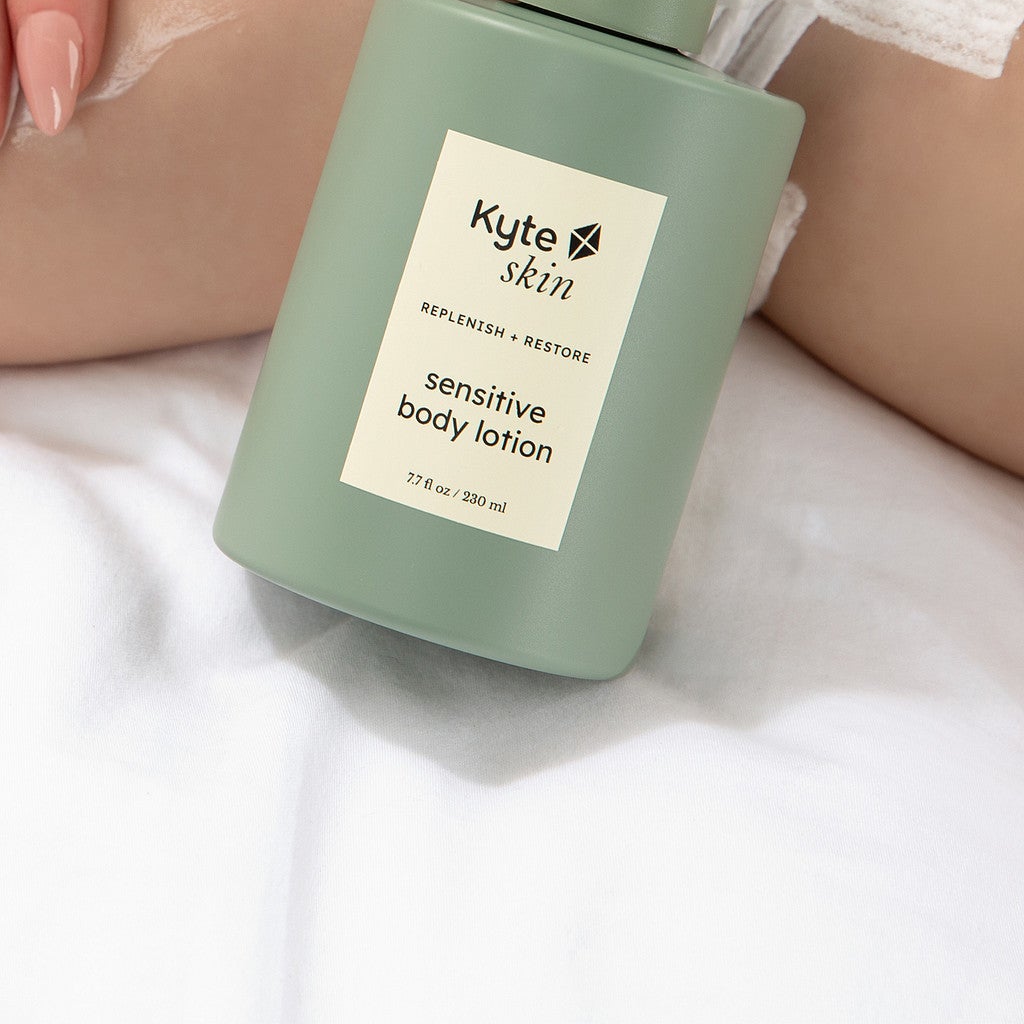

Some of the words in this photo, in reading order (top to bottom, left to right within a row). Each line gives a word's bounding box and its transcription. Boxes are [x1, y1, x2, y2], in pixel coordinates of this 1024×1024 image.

[470, 198, 558, 252] Kyte
[499, 254, 574, 301] skin
[420, 301, 506, 339] REPLENISH
[523, 335, 592, 364] RESTORE
[424, 372, 546, 424] sensitive
[397, 393, 470, 442] body
[474, 419, 553, 464] lotion
[406, 471, 423, 486] 7.7
[423, 477, 434, 491] fl
[435, 485, 451, 497] oz
[461, 490, 487, 507] 230
[488, 501, 507, 514] ml
